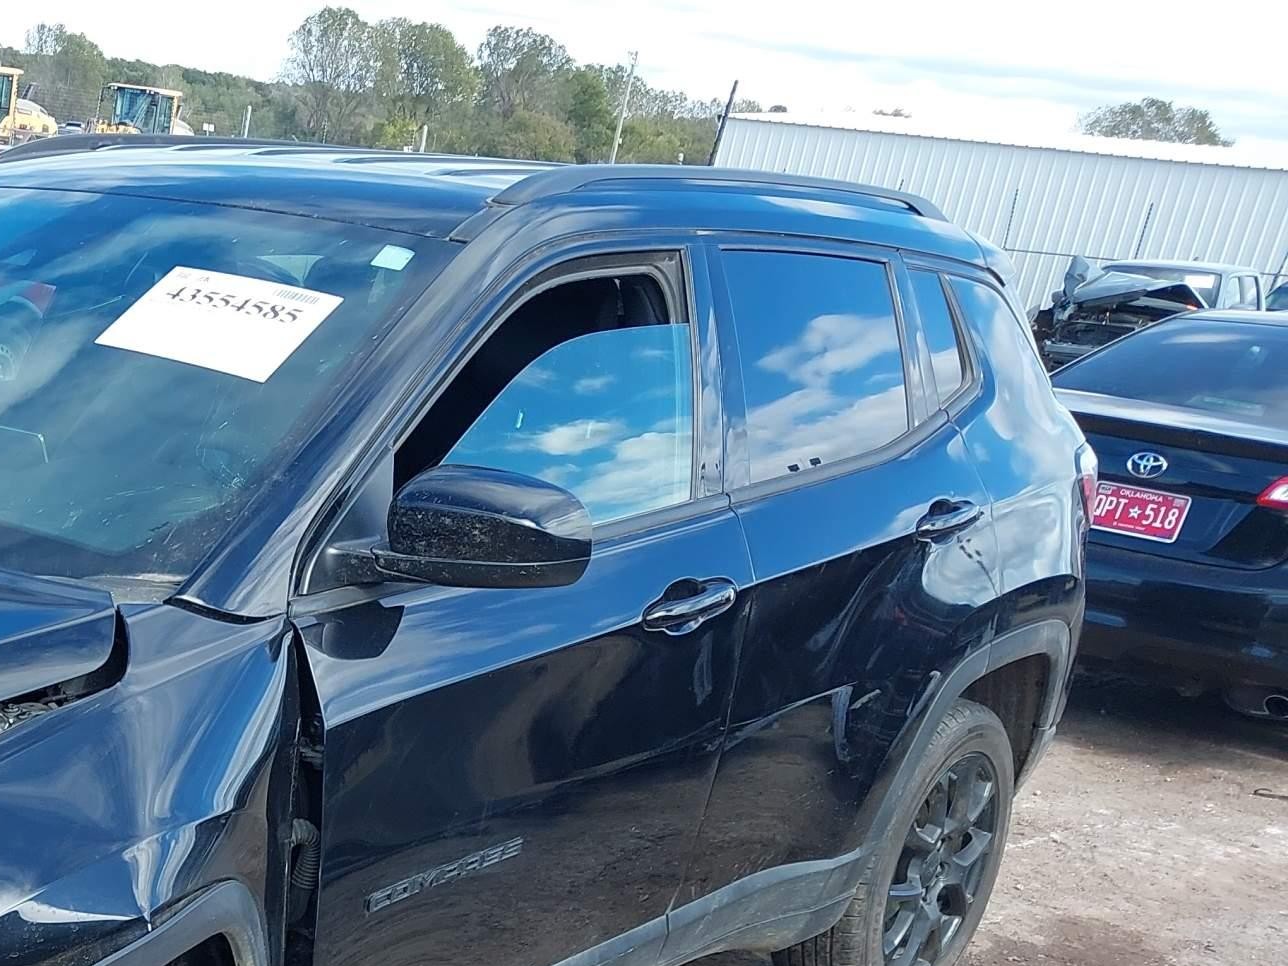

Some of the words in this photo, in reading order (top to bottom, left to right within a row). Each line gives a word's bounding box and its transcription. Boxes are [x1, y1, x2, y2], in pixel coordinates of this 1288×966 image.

[166, 286, 304, 323] 43554585
[1120, 488, 1163, 503] OKLAHOMA
[1141, 503, 1179, 530] 518
